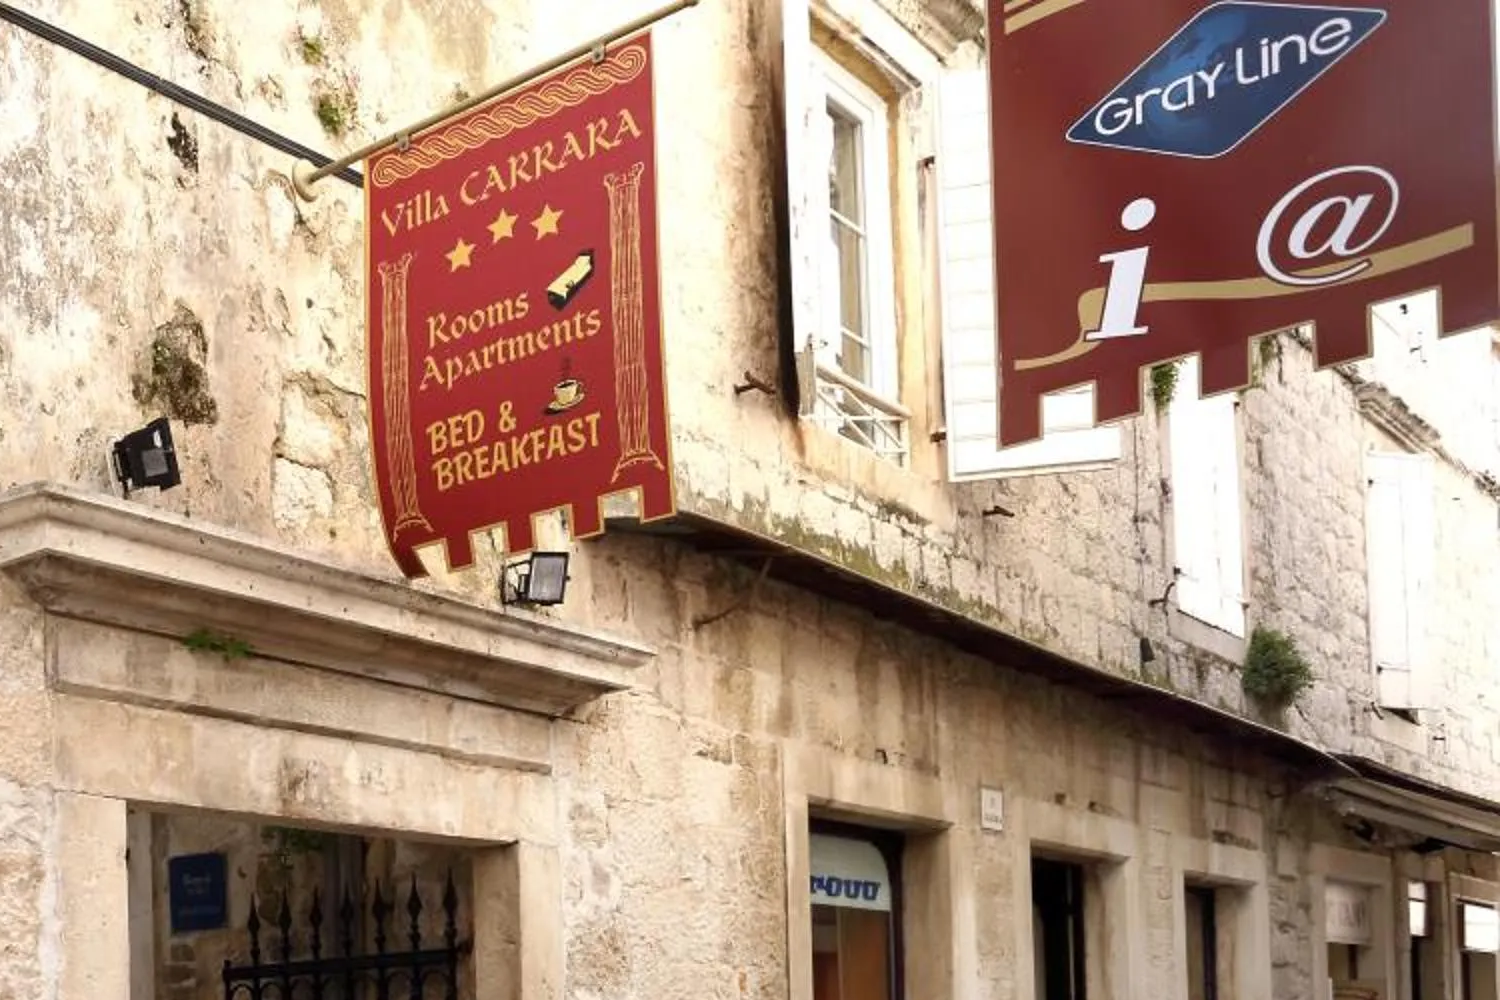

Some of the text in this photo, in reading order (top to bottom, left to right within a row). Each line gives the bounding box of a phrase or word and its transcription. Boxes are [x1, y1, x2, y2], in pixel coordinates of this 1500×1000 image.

[380, 107, 642, 238] Villa CARRARA
[419, 308, 601, 393] Apartments
[426, 291, 530, 350] Rooms
[426, 400, 516, 455] BED &
[431, 412, 601, 491] BREAKFAST
